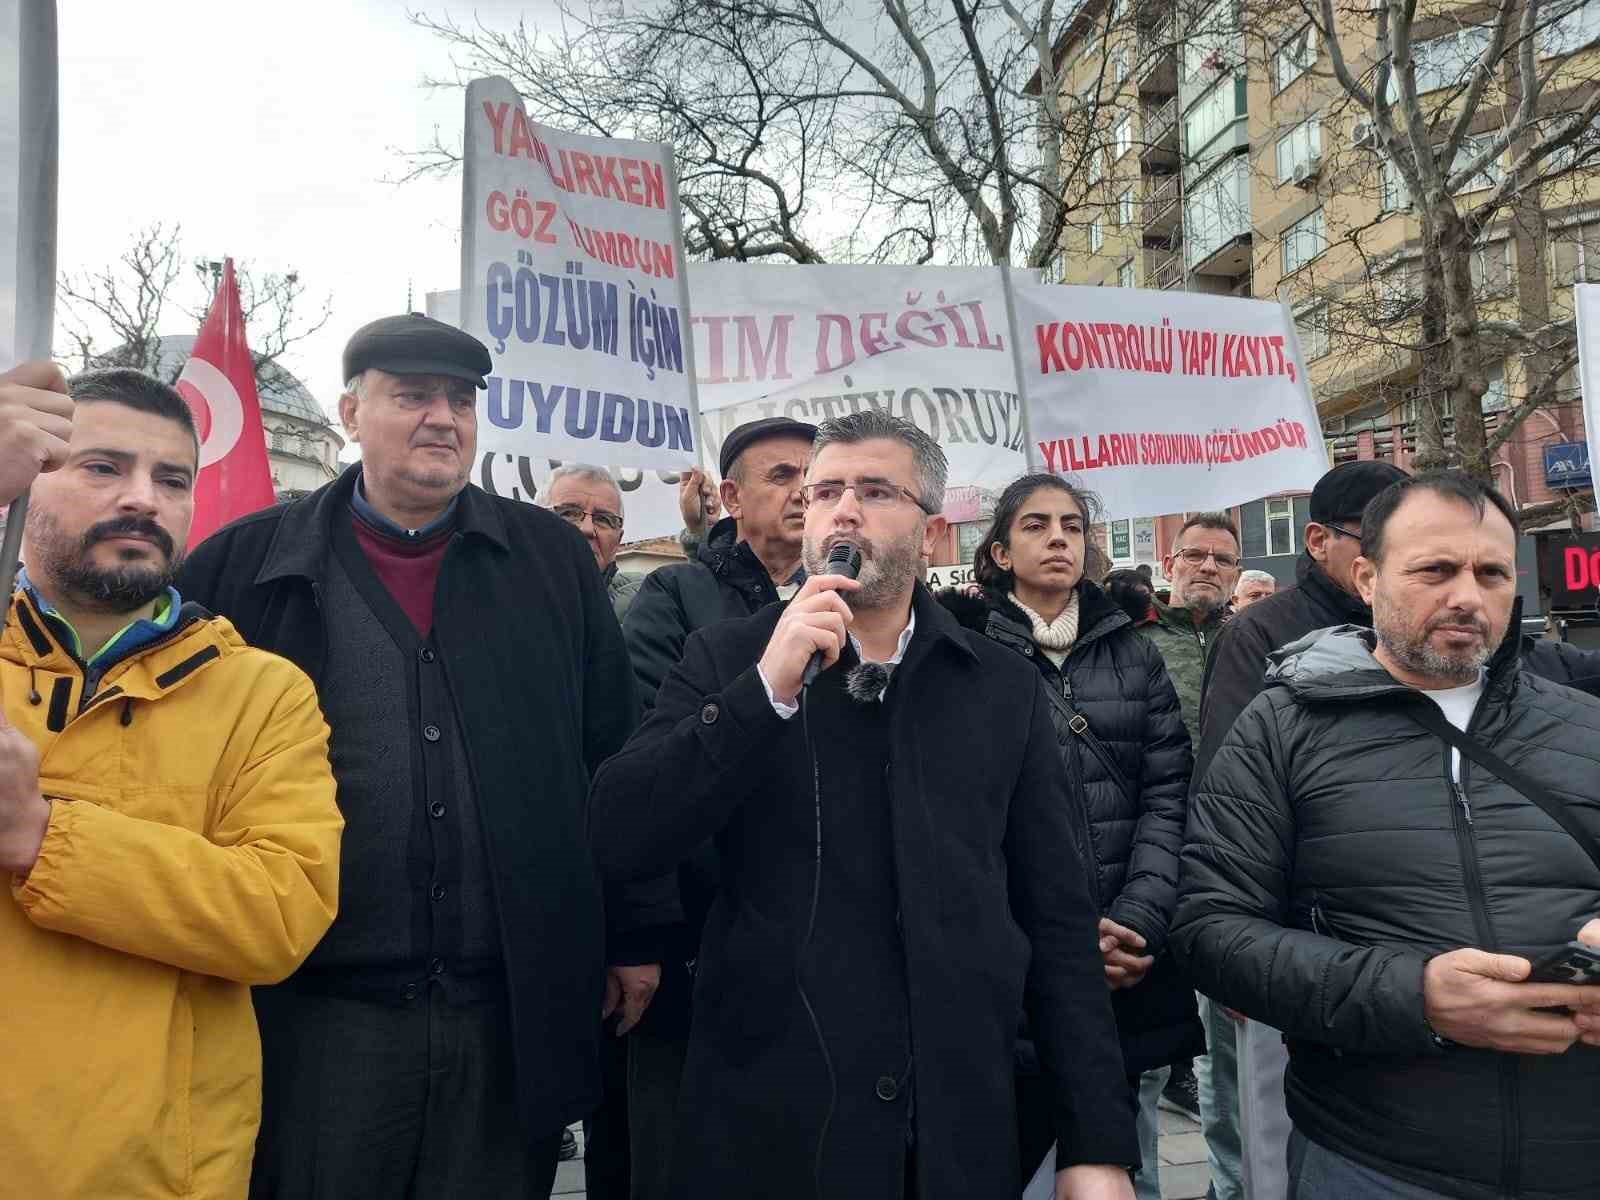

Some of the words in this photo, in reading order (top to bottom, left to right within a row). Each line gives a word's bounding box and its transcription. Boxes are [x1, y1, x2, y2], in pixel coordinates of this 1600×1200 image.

[483, 100, 666, 210] YALIRKEN
[485, 189, 557, 244] GÖZ
[486, 249, 619, 356] ÇÖZÜM
[627, 279, 684, 381] İÇİN
[688, 314, 794, 384] IM
[814, 289, 1005, 375] DEĞİL
[1036, 317, 1173, 375] KONTROLLÜ
[1178, 328, 1217, 377] YAPI
[1222, 333, 1297, 384] KAYIT,
[487, 376, 694, 452] UYUDUN
[1038, 431, 1139, 473] YILLARIN
[1141, 432, 1203, 466] SORUNUNA
[1204, 417, 1308, 472] ÇÖZÜMDÜR
